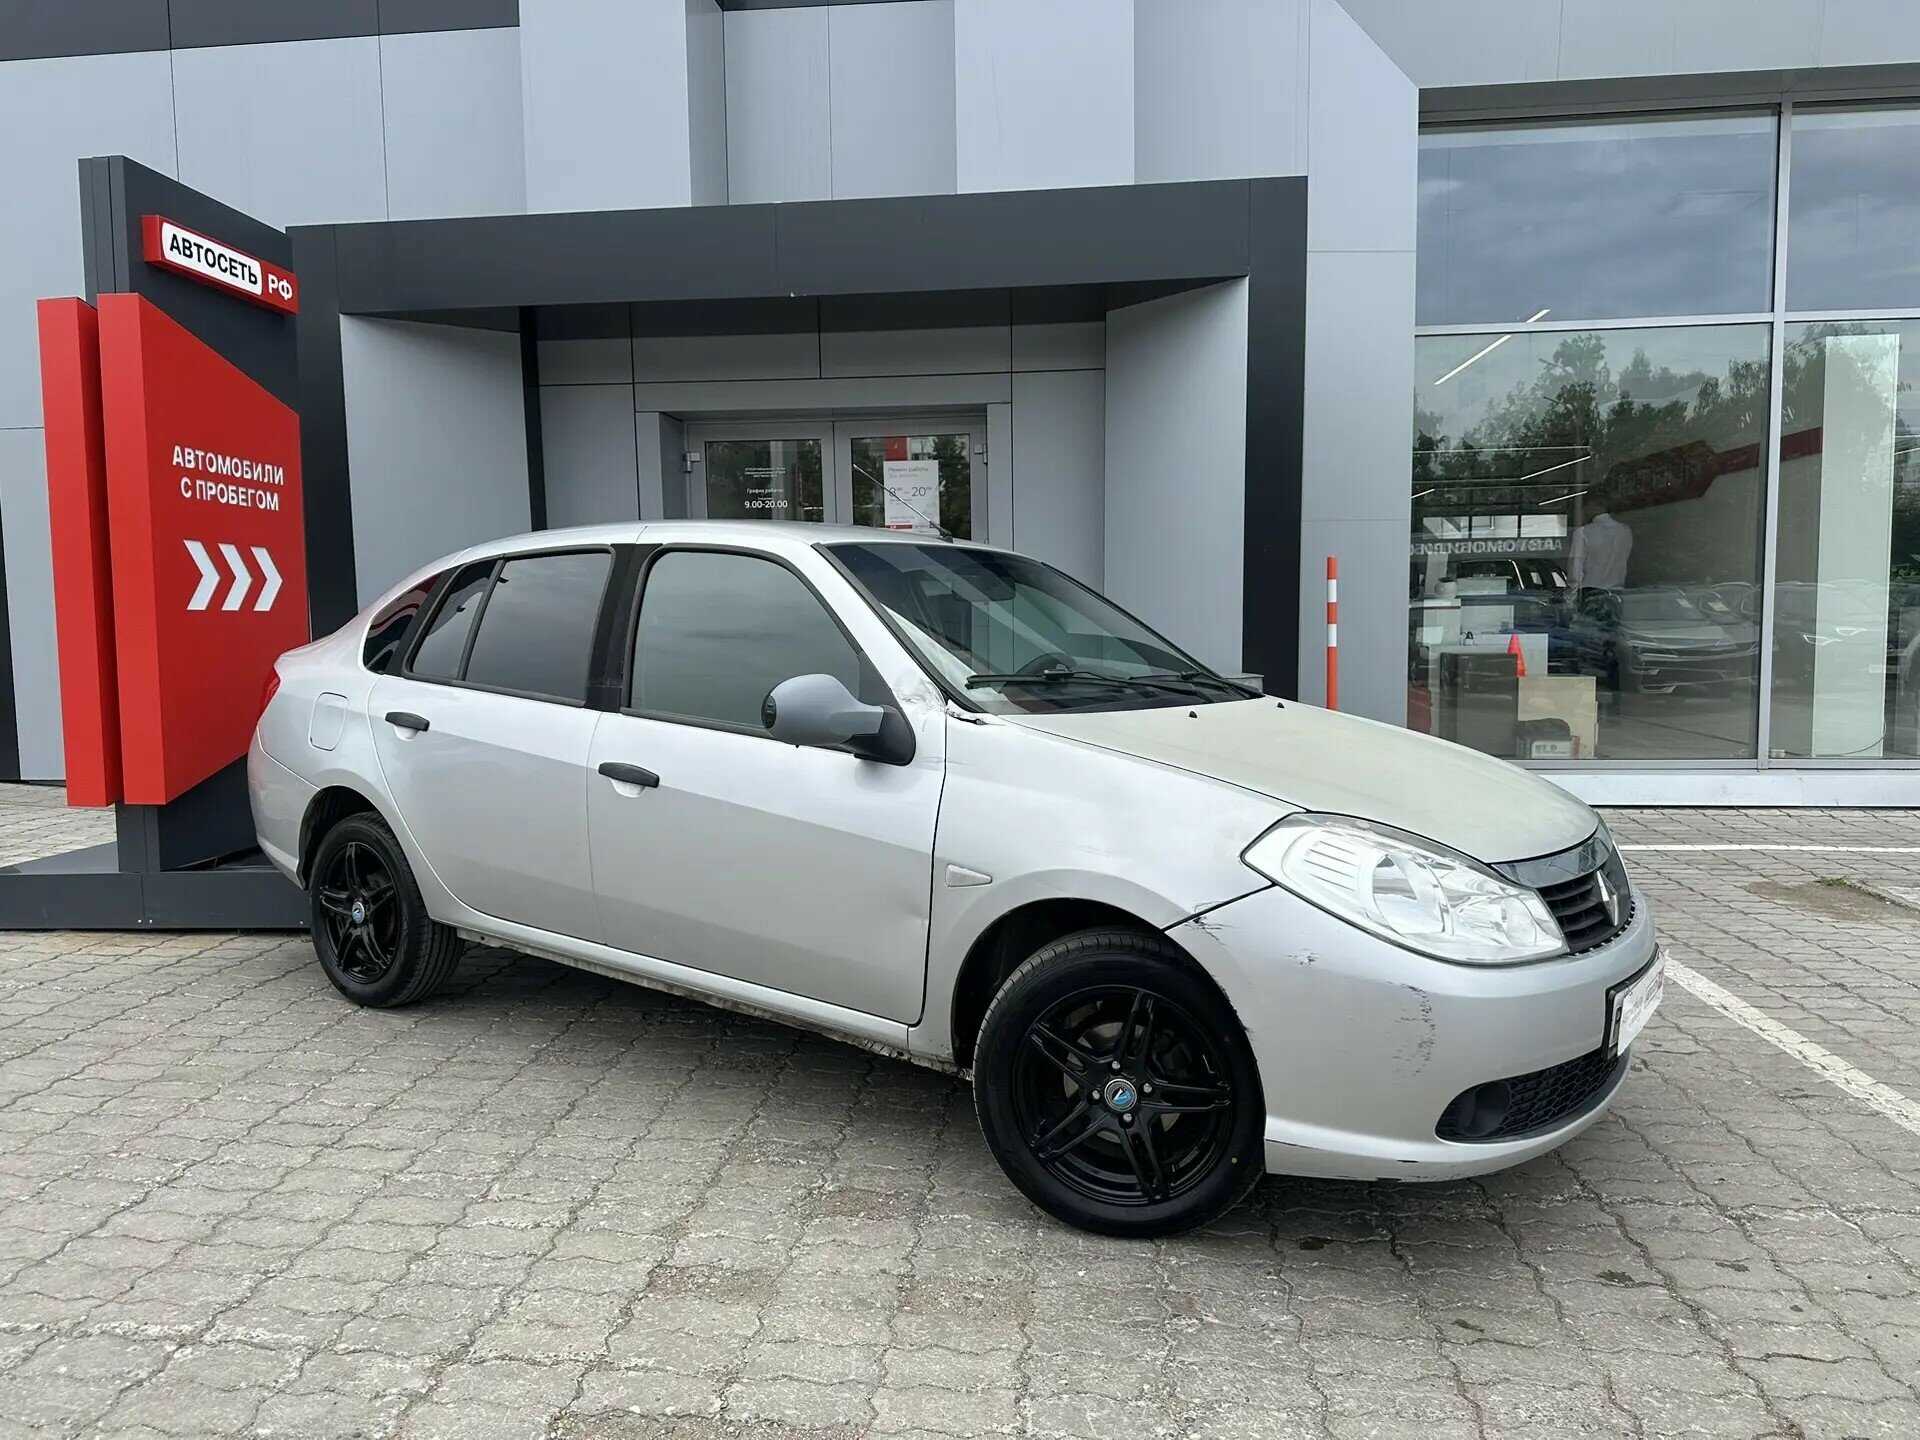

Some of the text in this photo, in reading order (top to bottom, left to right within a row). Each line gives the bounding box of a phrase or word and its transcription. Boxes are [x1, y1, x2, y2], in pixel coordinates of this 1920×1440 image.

[169, 233, 293, 301] АВТОСЕТЬ РФ
[172, 445, 284, 486] АВТОМОБИЛИ
[180, 476, 279, 511] С ПРОБЕГОМ
